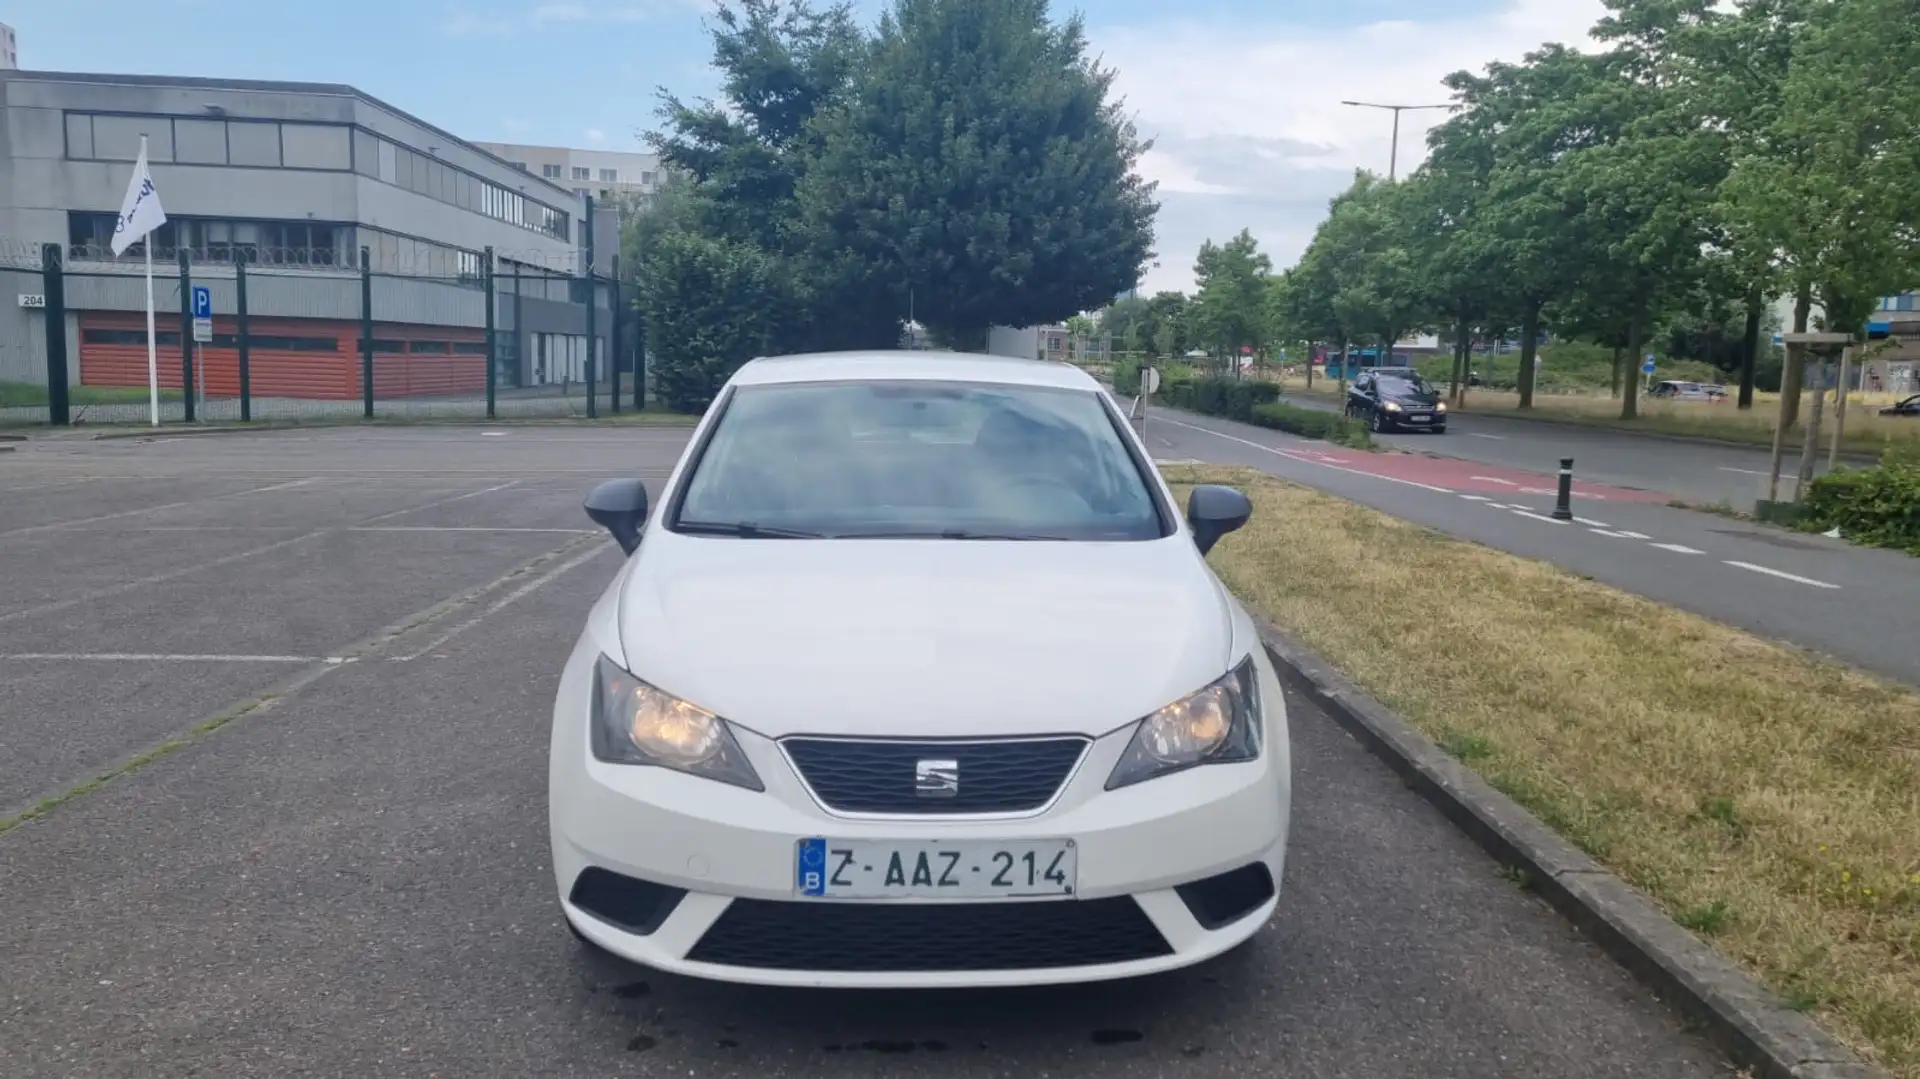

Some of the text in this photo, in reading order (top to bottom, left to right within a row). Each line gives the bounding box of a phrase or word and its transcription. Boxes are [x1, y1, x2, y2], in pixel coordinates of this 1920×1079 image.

[23, 296, 43, 305] 204
[198, 290, 208, 315] P
[829, 849, 1066, 887] Z-AAZ-214
[805, 872, 820, 889] B
